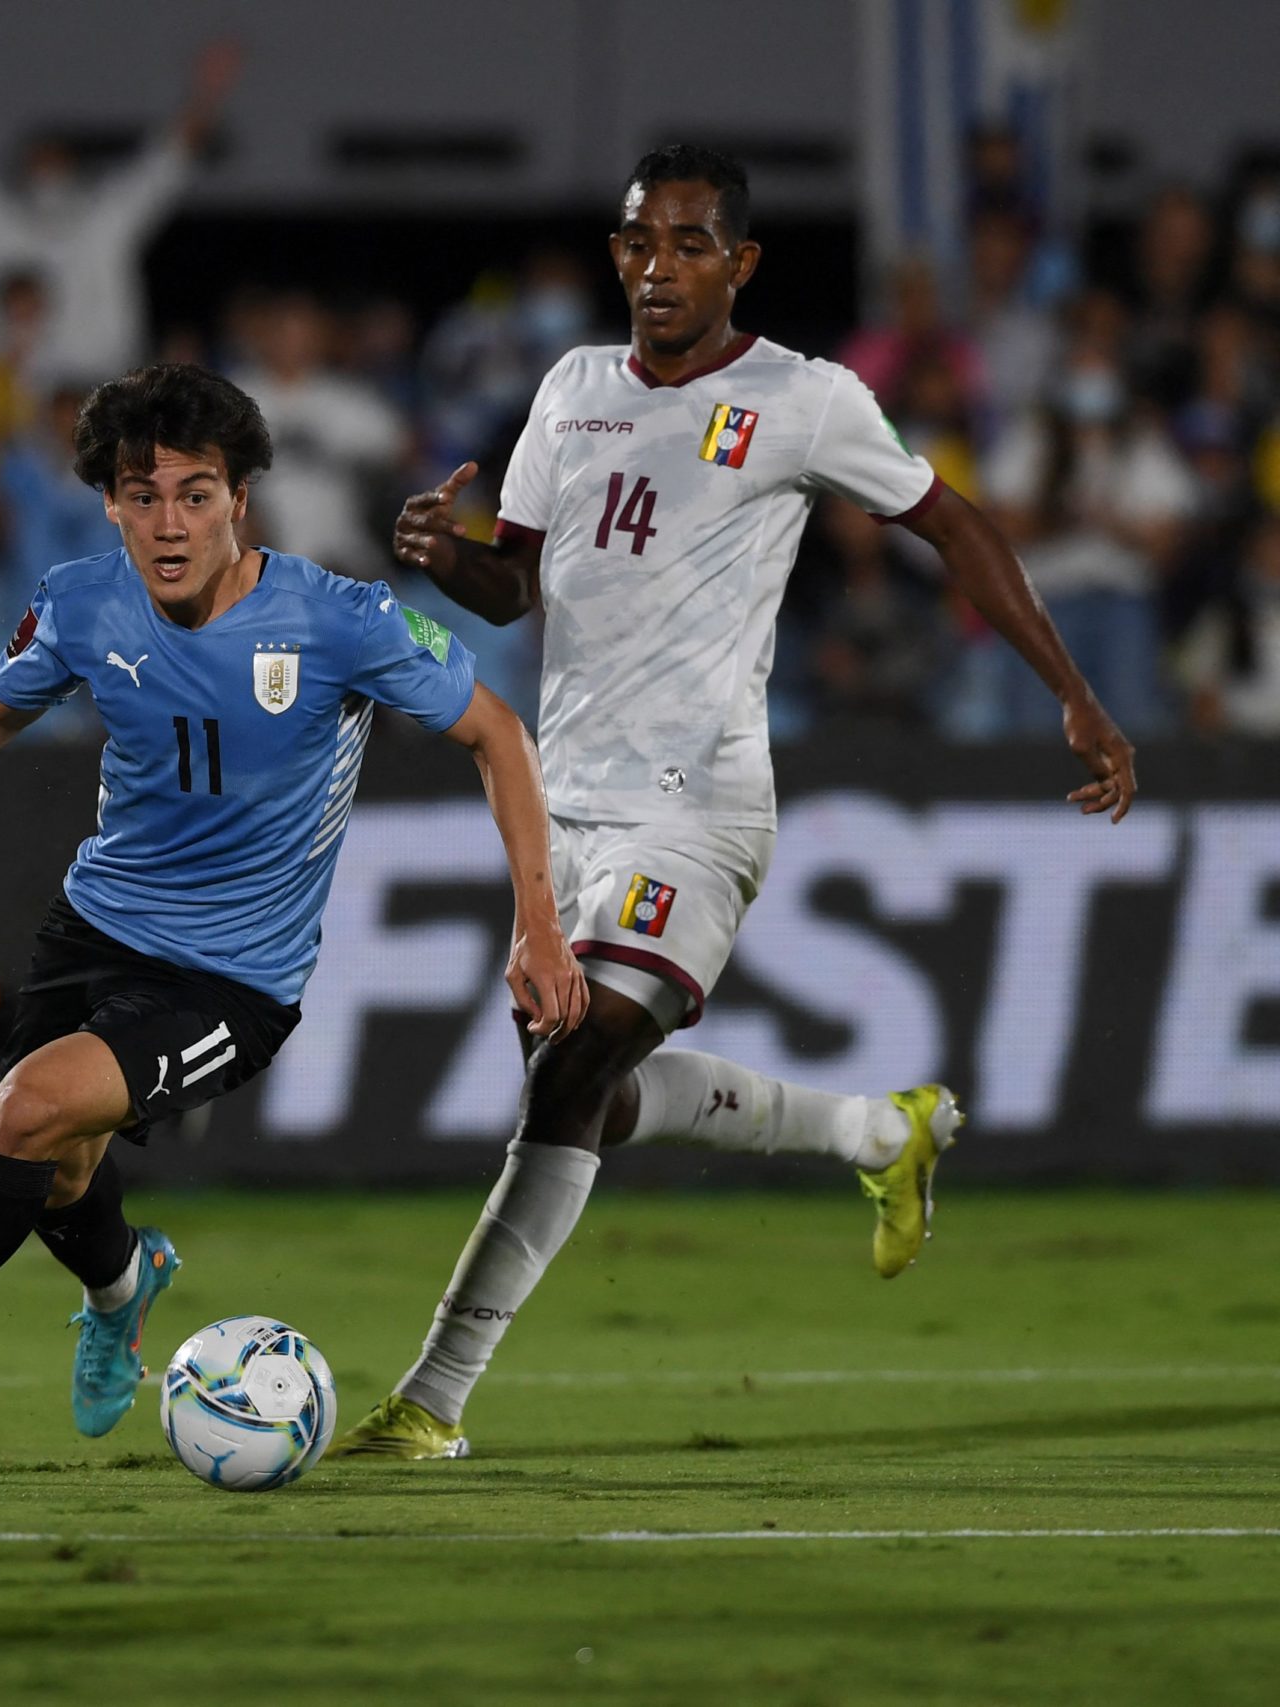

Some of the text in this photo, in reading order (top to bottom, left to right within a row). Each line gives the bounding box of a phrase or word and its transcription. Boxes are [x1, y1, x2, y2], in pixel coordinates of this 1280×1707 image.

[555, 420, 634, 434] GIVOVA
[594, 472, 657, 556] 14
[173, 716, 222, 795] 11
[258, 792, 1280, 1136] FSTE
[181, 1021, 236, 1088] 11
